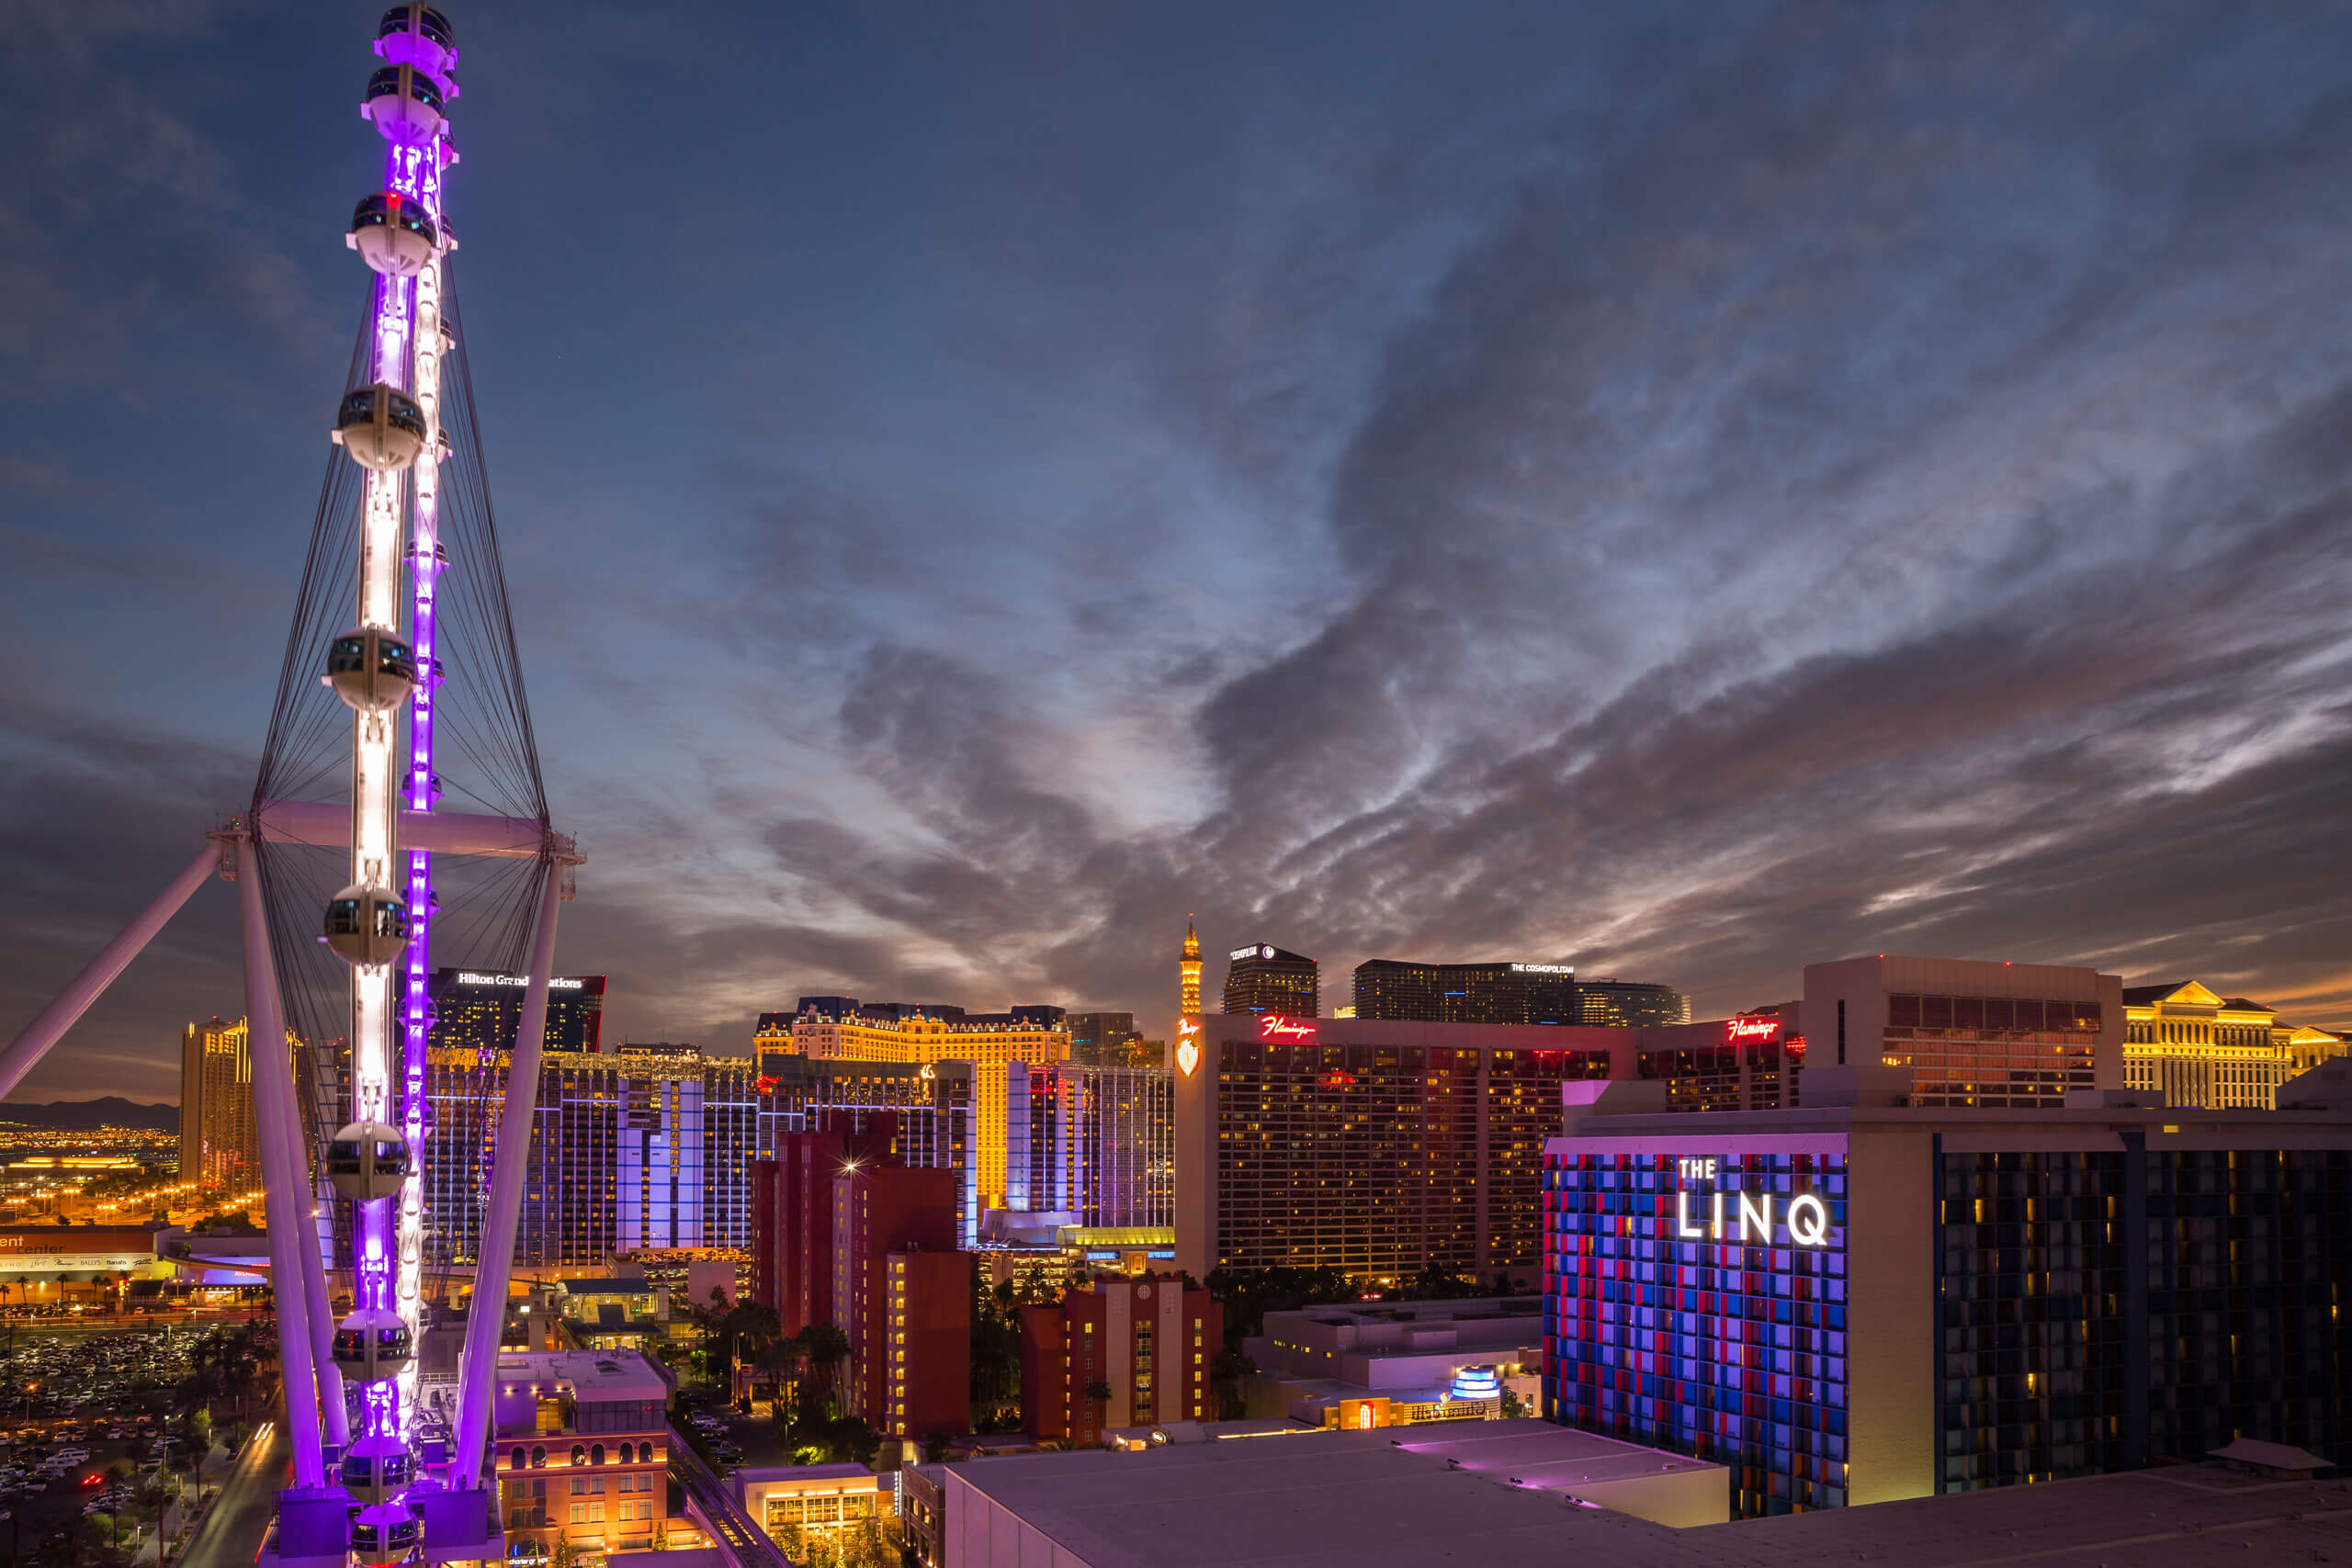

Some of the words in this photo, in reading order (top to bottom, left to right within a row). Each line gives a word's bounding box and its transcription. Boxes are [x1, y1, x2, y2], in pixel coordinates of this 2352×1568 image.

[1511, 963, 1525, 972] THE
[1526, 964, 1574, 974] COSMOPOLITAN
[458, 973, 494, 986] Hilton
[1261, 1016, 1316, 1039] Flamingo
[1726, 1018, 1779, 1042] Flamingo
[1679, 1158, 1716, 1179] THE
[1679, 1190, 1827, 1247] LINQ
[16, 1244, 65, 1254] center
